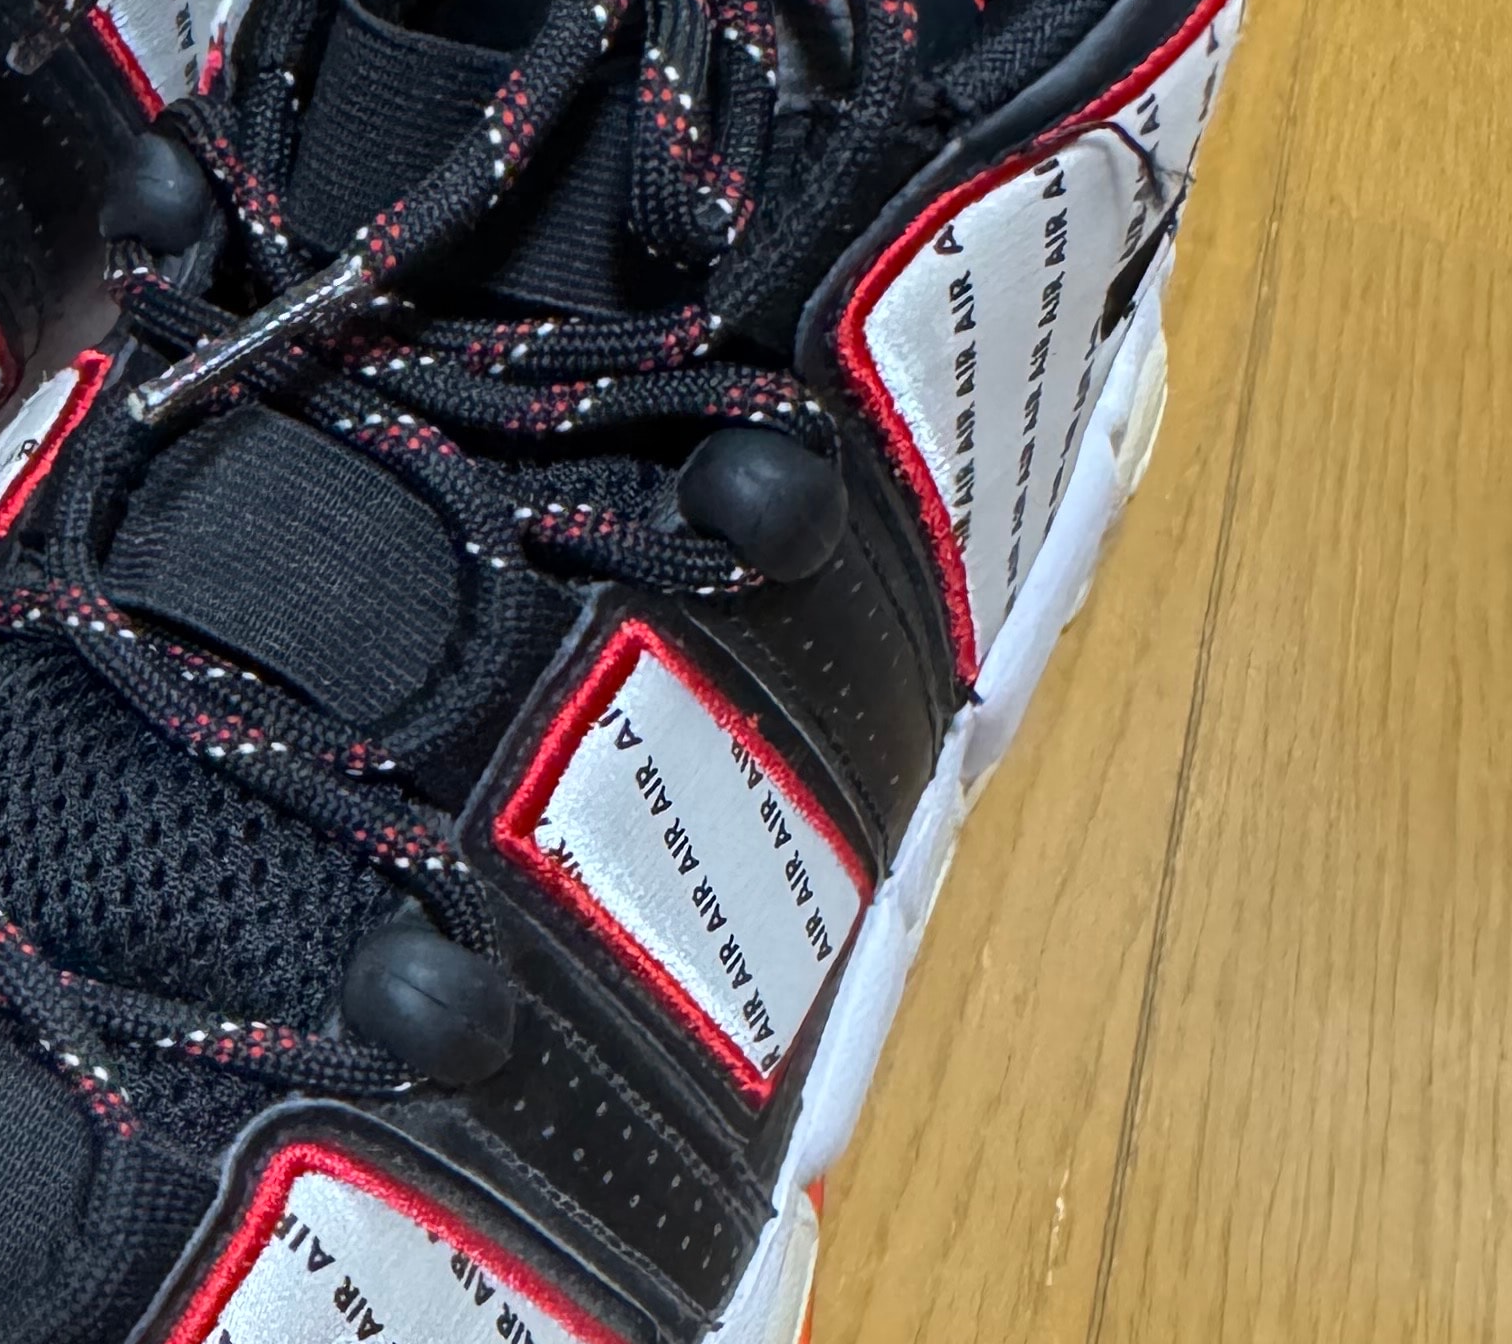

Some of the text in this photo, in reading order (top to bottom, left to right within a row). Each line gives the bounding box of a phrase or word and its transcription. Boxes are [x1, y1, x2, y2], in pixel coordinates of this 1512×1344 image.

[1033, 159, 1067, 200] AI
[1044, 207, 1068, 268] AIR
[948, 269, 977, 335] AIR
[1037, 270, 1066, 329] AIR
[954, 339, 978, 398] AIR
[955, 400, 976, 456] AIR
[597, 707, 644, 751] AI
[634, 754, 673, 817] AIR
[663, 816, 700, 876] AIR
[759, 789, 793, 850] AIR
[691, 874, 728, 933] AIR
[785, 849, 814, 907] AIR
[718, 933, 753, 990] AIR
[805, 906, 834, 962] AIR
[742, 987, 775, 1043] AIR
[332, 1275, 385, 1342] AIR
